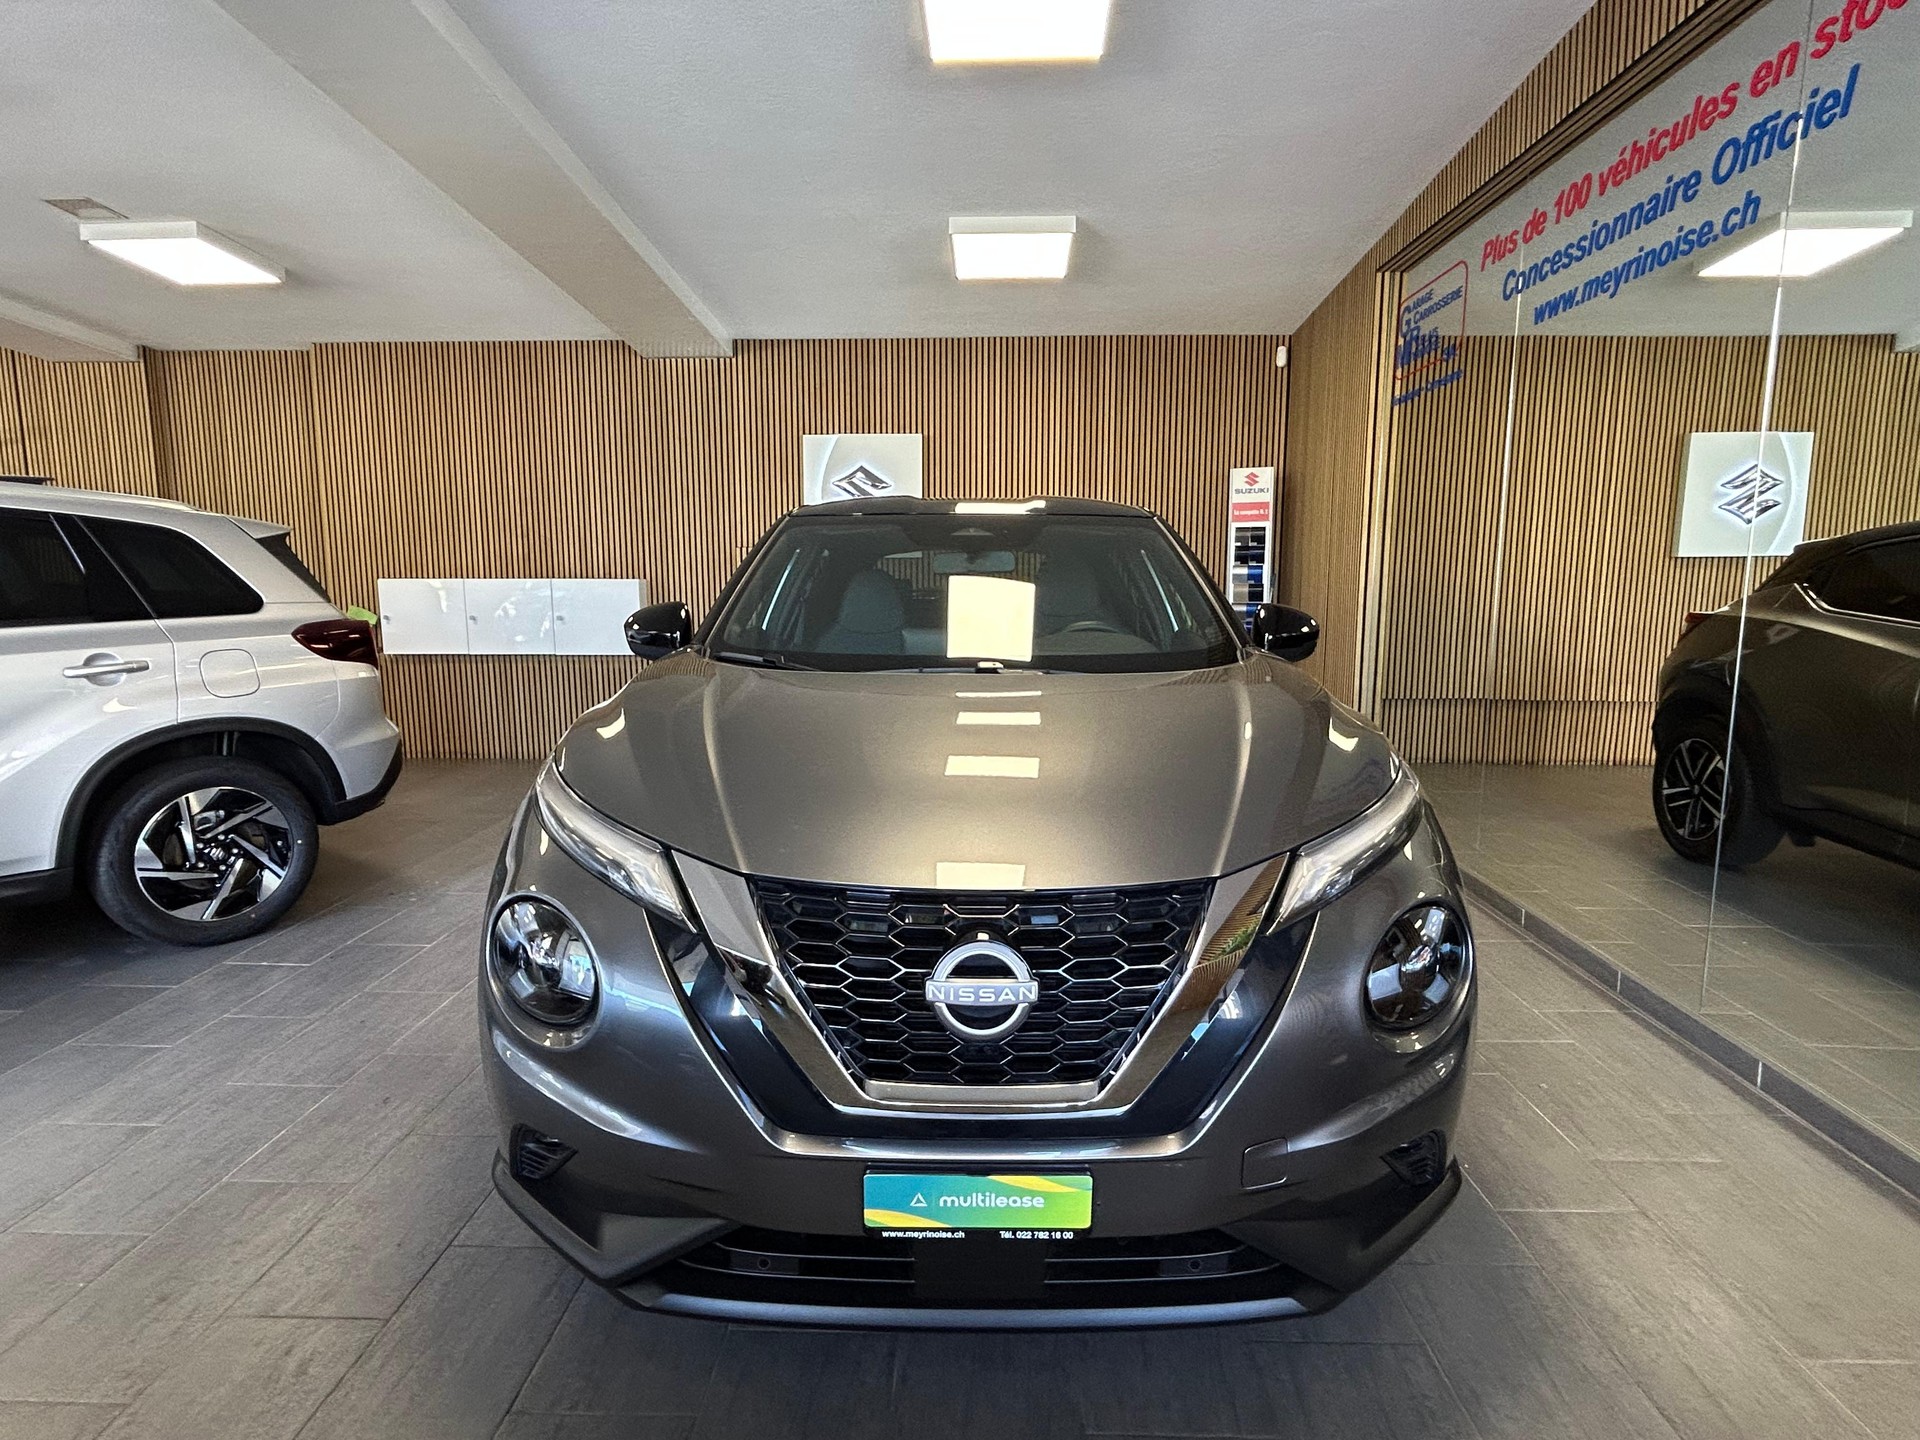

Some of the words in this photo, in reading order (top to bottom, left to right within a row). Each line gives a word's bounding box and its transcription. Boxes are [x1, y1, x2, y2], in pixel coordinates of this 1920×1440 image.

[1480, 229, 1520, 272] Plus
[1522, 207, 1548, 245] de
[1554, 172, 1593, 225] 100
[1598, 82, 1741, 197] véhicules
[1750, 41, 1801, 98] en
[1810, 0, 1909, 59] sto
[1502, 169, 1703, 301] Concessionnaire
[1711, 62, 1862, 186] Officiel
[1533, 189, 1762, 326] www.meyrinoise.ch
[928, 985, 1036, 1002] NISSAN
[939, 1192, 1045, 1208] multilease
[881, 1230, 965, 1239] www.meyrinoise.ch
[1016, 1230, 1032, 1239] 022
[1062, 1231, 1074, 1239] 00
